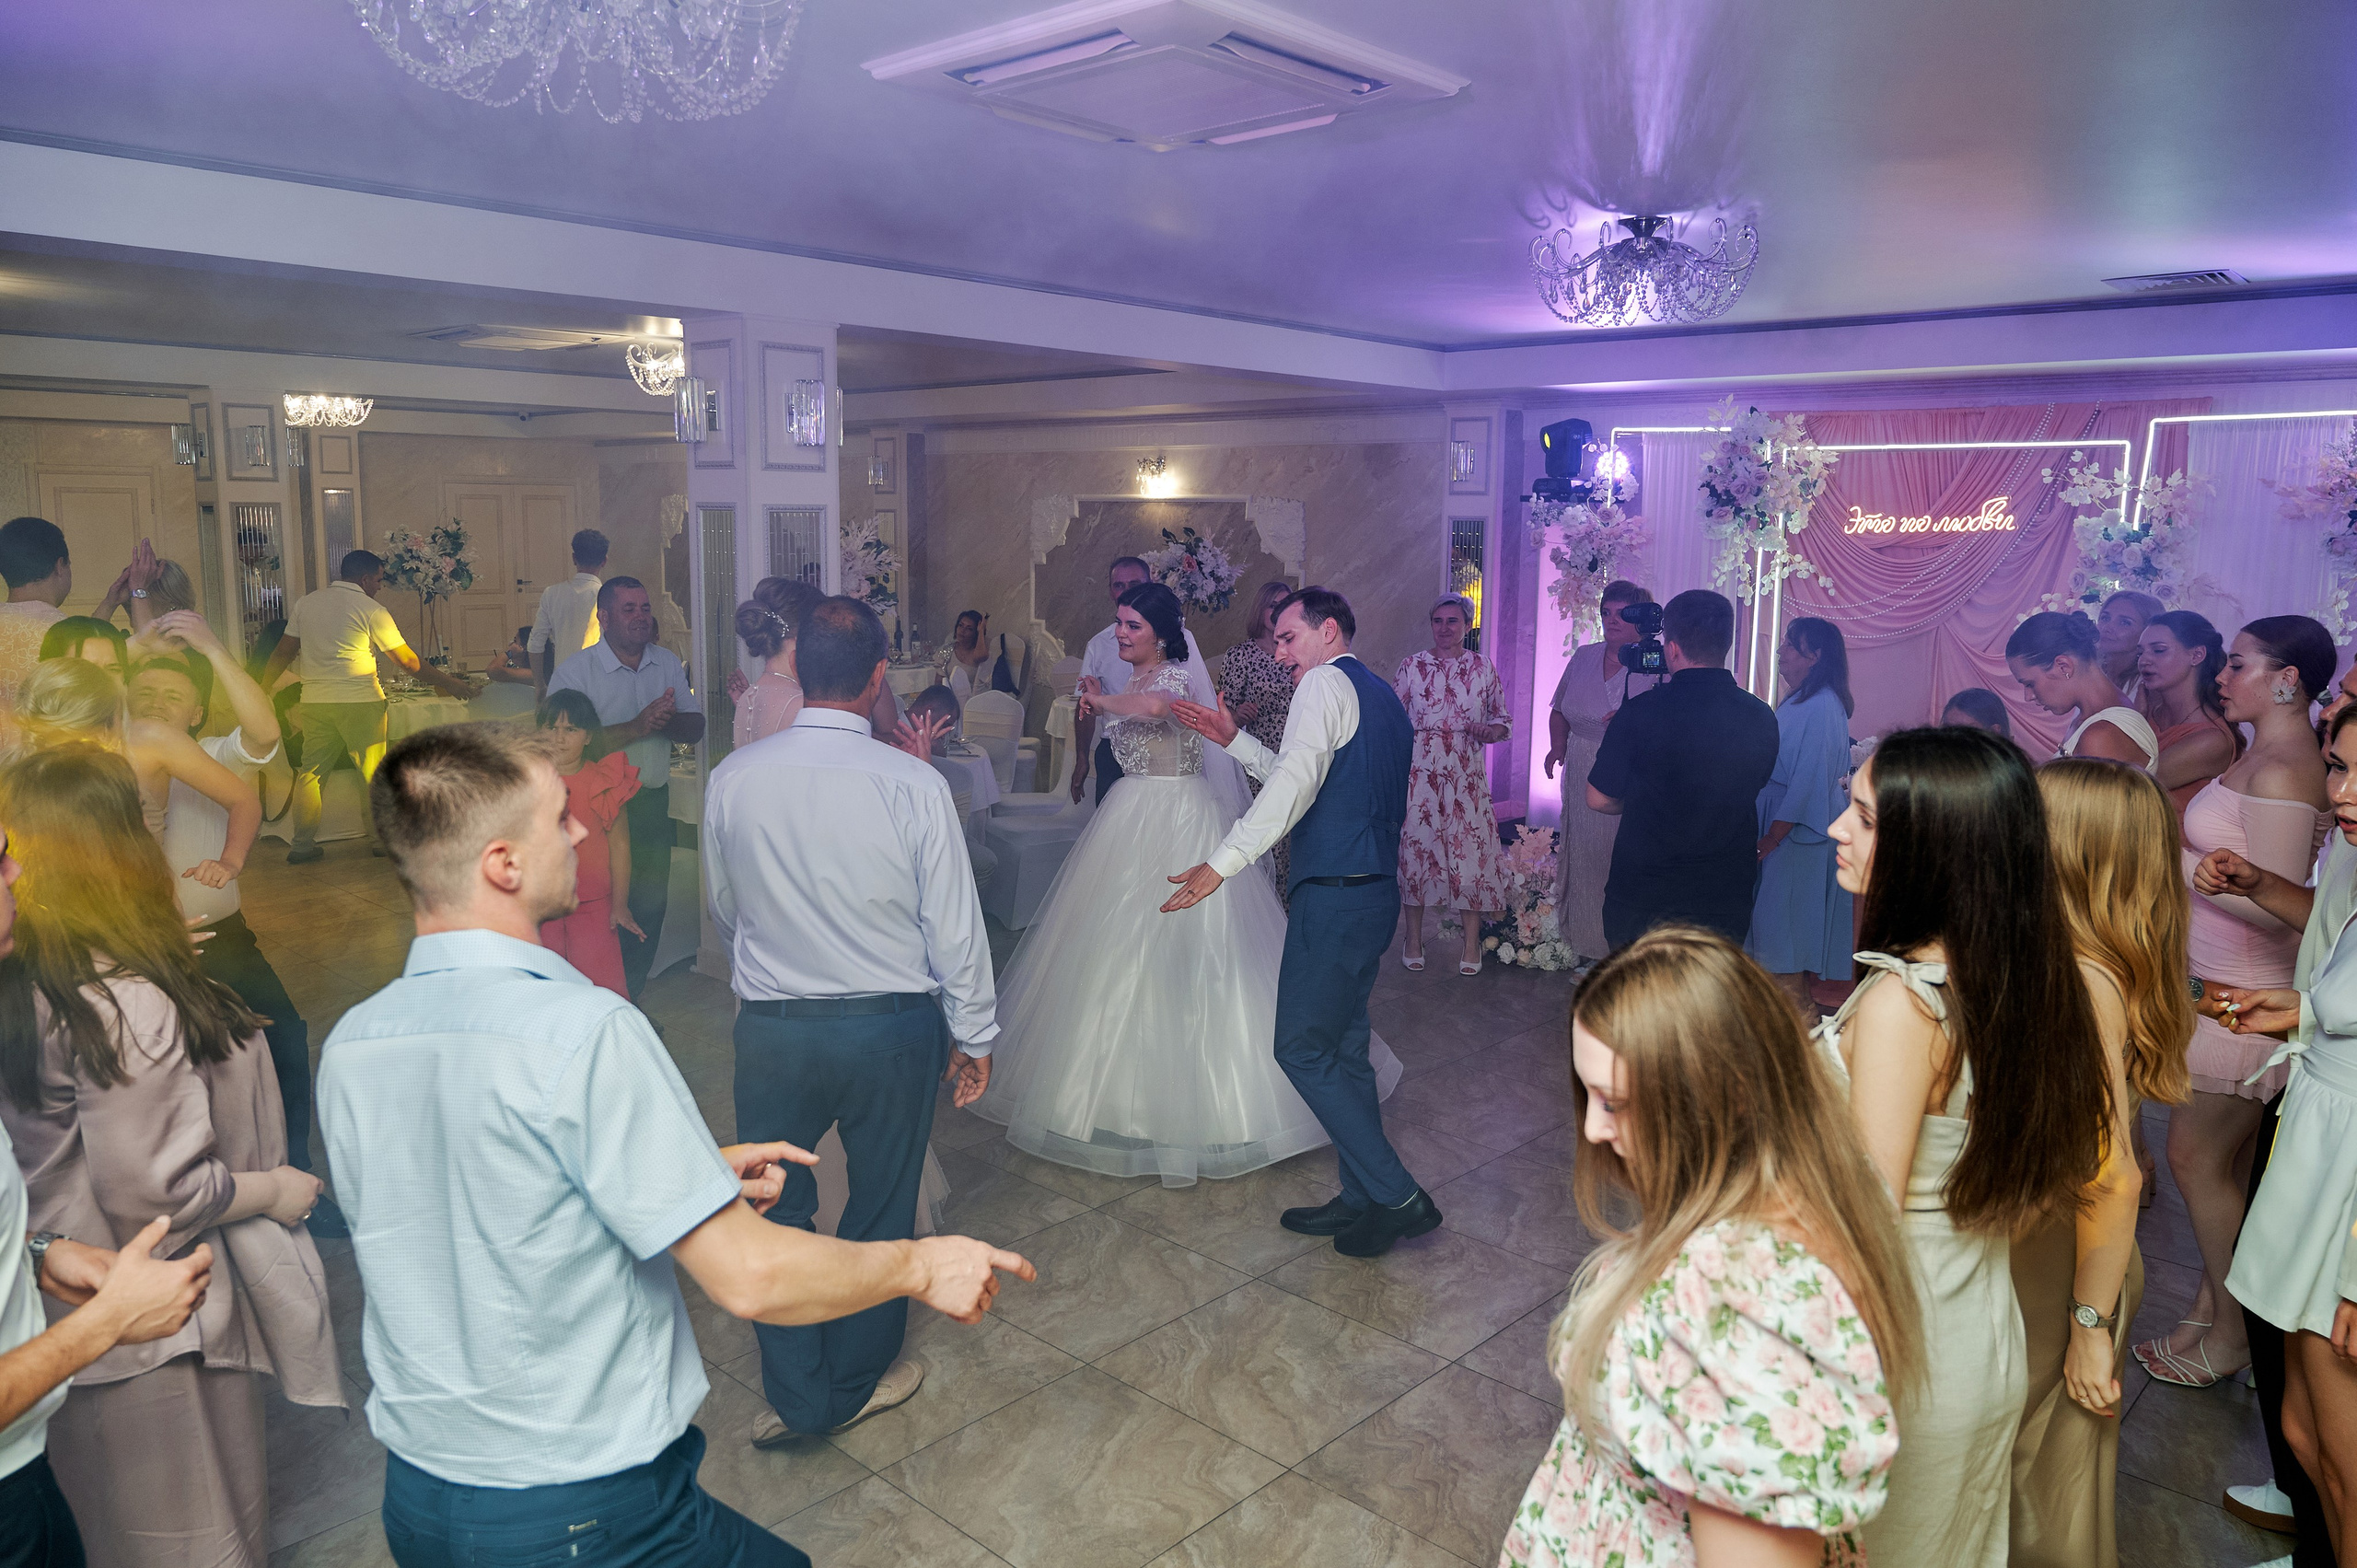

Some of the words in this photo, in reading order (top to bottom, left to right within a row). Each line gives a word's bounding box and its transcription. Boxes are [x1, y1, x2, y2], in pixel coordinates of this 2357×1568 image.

[1844, 505, 1896, 534] Это
[1898, 515, 1932, 533] по
[1933, 495, 2016, 532] любви
